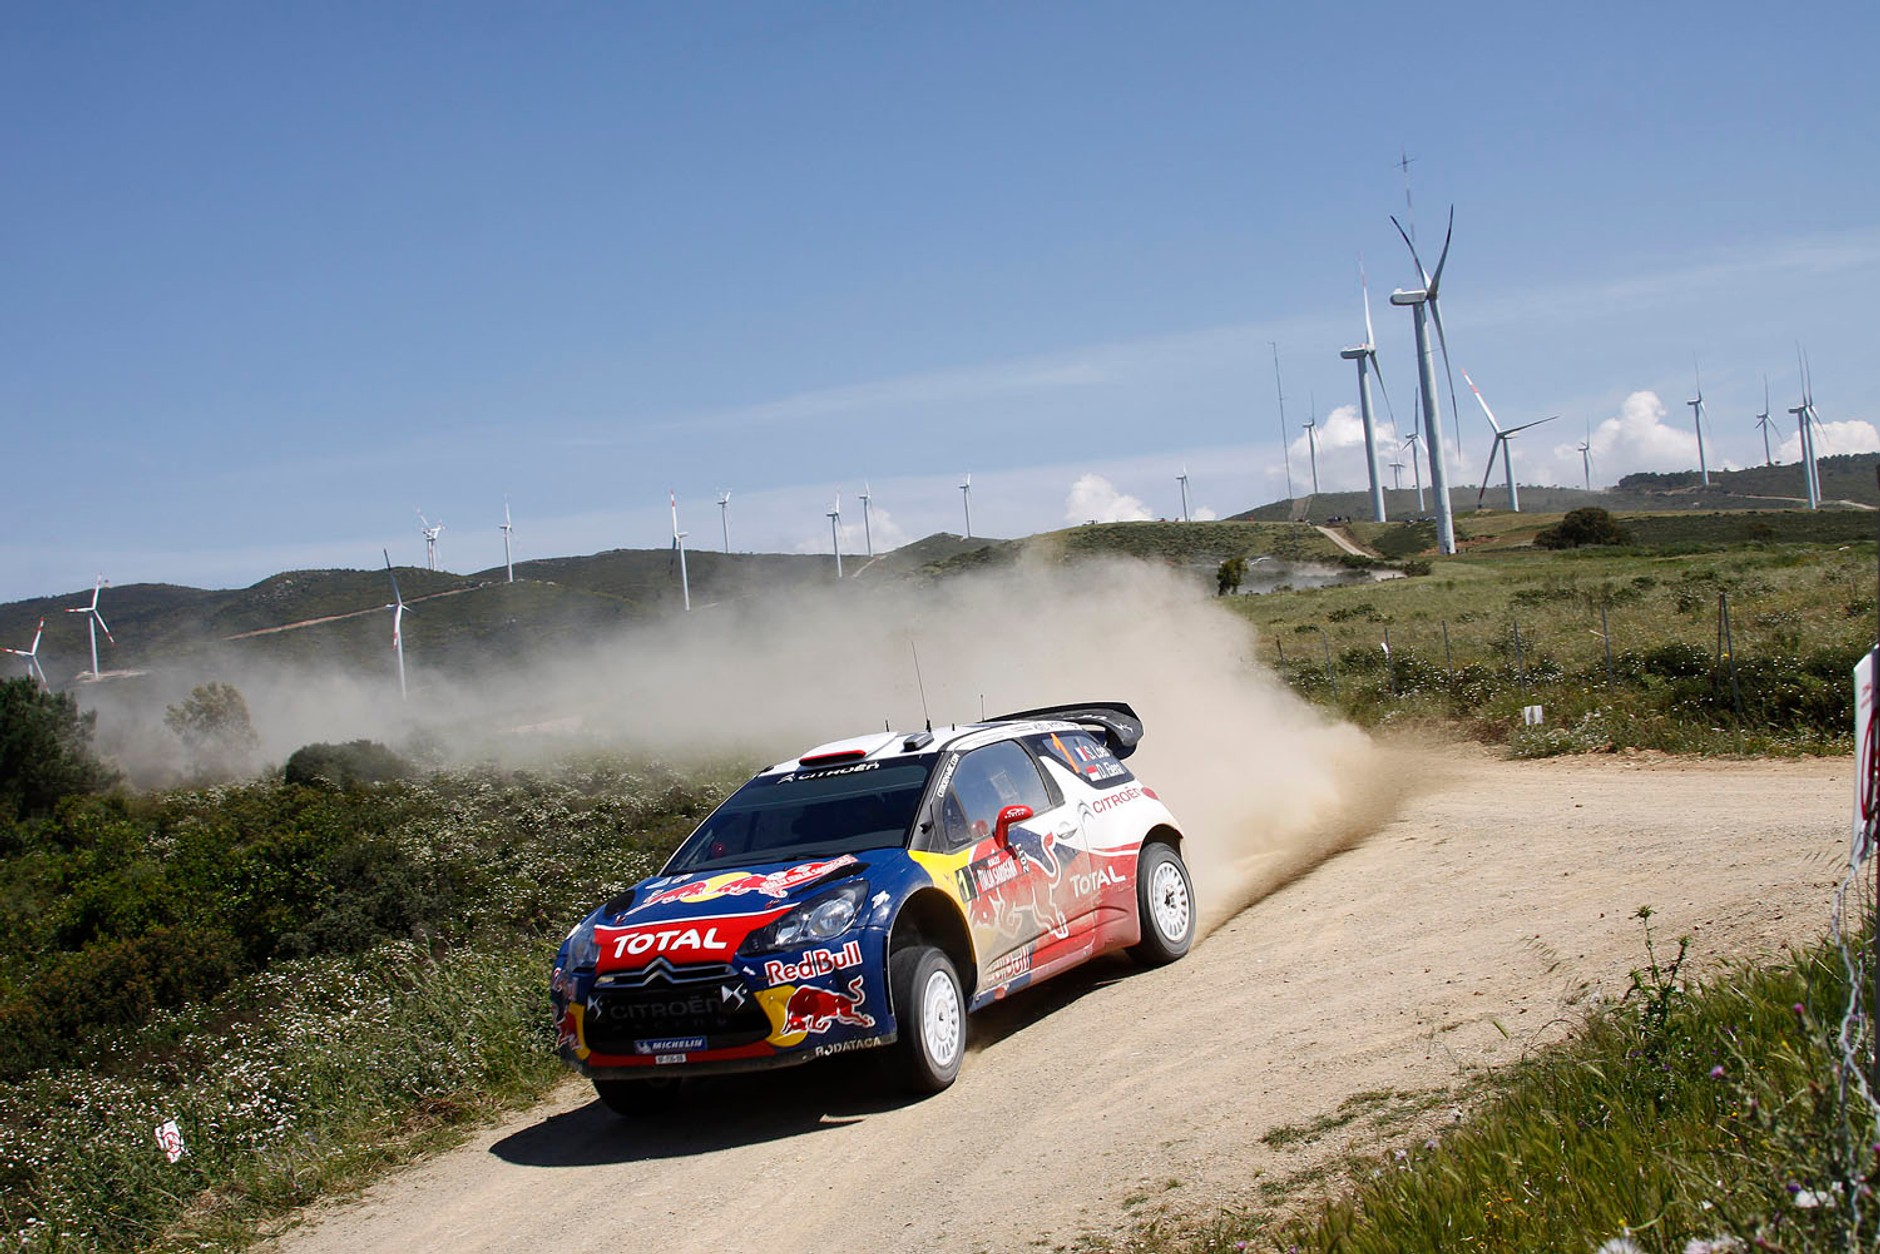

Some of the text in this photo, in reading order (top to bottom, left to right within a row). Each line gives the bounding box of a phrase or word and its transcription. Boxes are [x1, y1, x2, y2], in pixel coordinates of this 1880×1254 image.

[1092, 786, 1141, 813] CITROËN
[958, 869, 971, 901] 1
[1069, 865, 1127, 898] TOTAL
[613, 927, 728, 958] TOTAL
[609, 994, 722, 1020] CITROËN
[652, 1039, 703, 1051] MICHELIN
